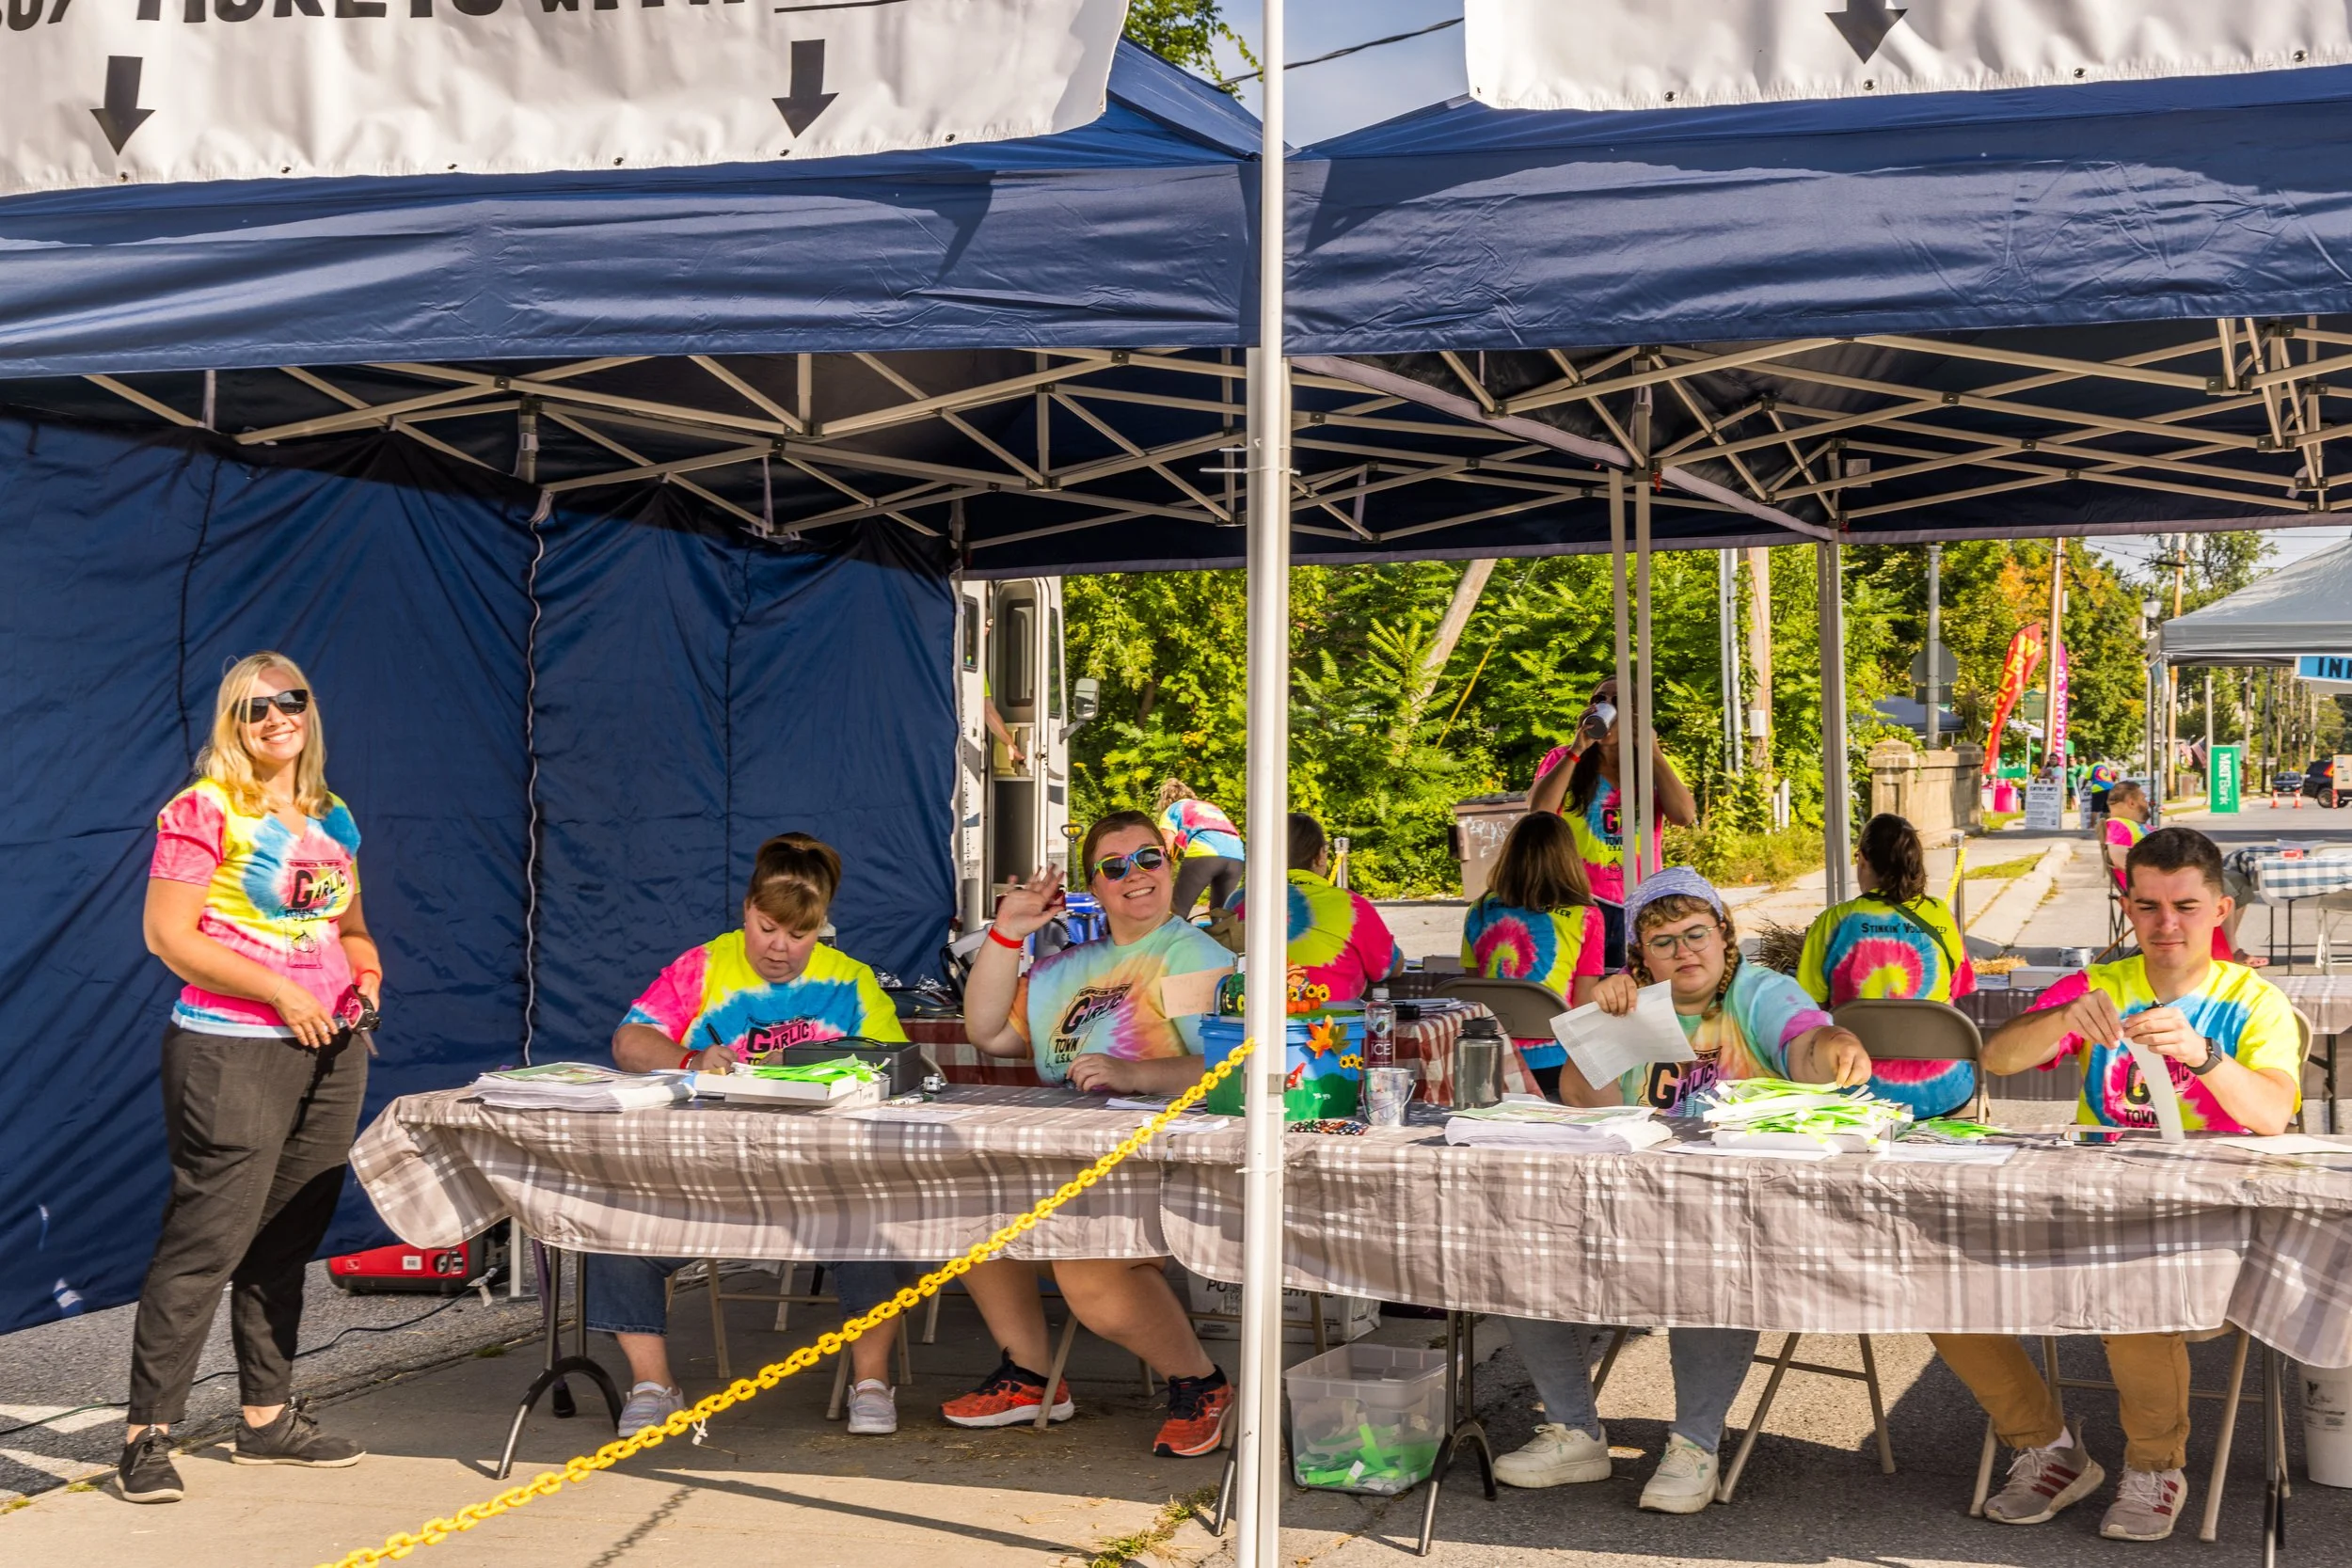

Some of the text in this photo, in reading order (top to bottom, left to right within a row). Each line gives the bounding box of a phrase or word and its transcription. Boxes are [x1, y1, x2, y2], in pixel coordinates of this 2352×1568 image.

[292, 869, 345, 909] GARLIC
[1862, 923, 1900, 933] STINKIN'
[1061, 993, 1123, 1035] GARLIC
[746, 1022, 810, 1053] GARLIC
[1055, 1037, 1080, 1053] TOWN
[1371, 1043, 1391, 1054] ICE
[745, 1056, 762, 1066] TO
[1648, 1062, 1714, 1109] GALIC
